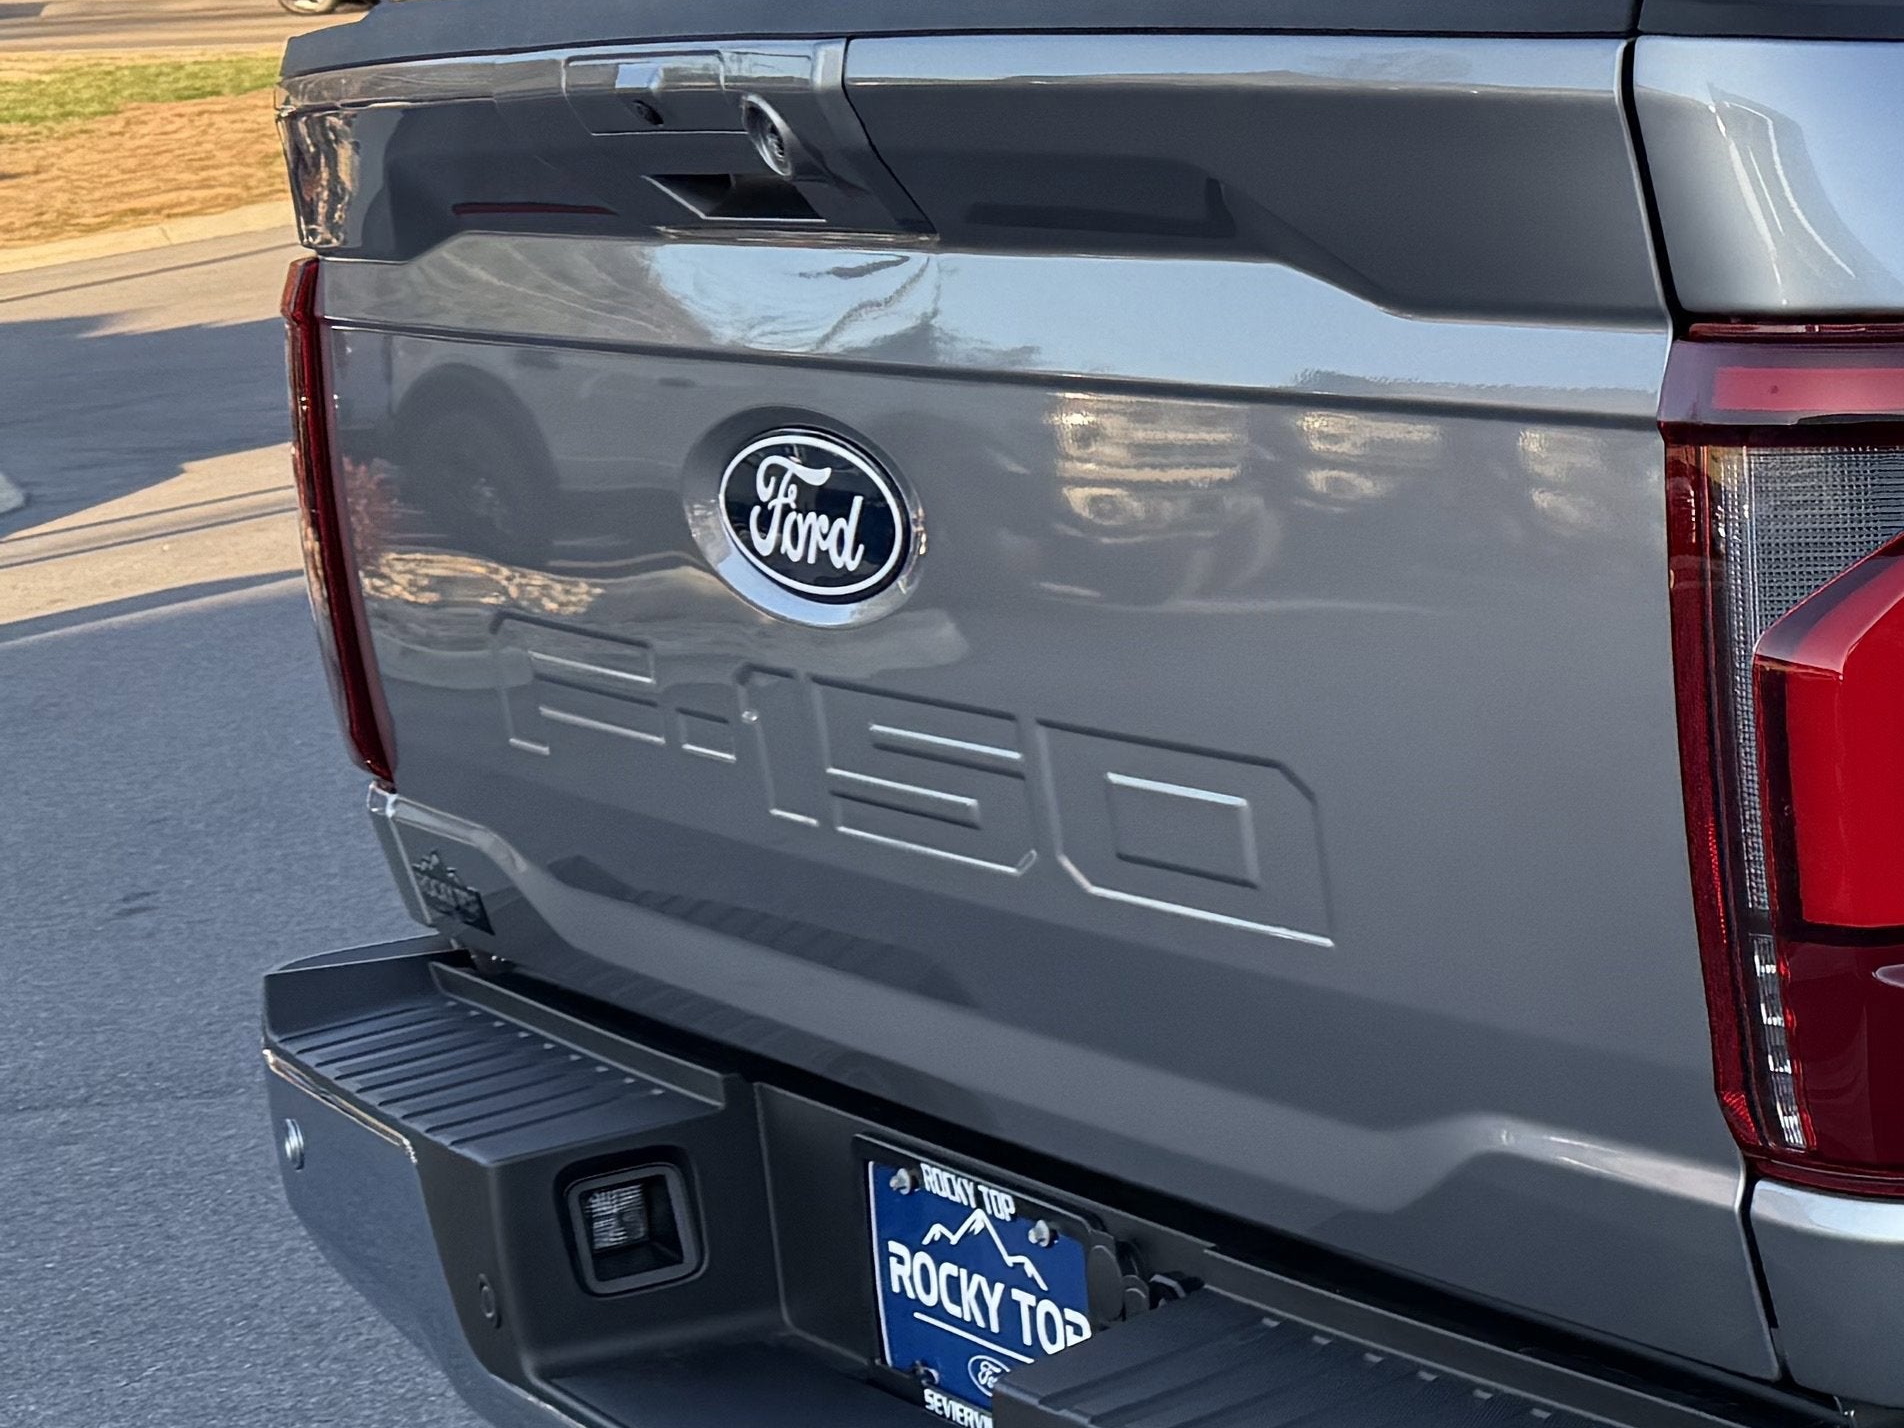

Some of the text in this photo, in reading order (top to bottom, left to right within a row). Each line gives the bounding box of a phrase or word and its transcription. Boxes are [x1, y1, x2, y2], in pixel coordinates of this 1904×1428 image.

[749, 454, 865, 571] Ford
[490, 609, 1335, 948] F-150
[920, 1162, 1016, 1222] ROCKY TOP
[887, 1239, 1092, 1354] ROCKY TOP
